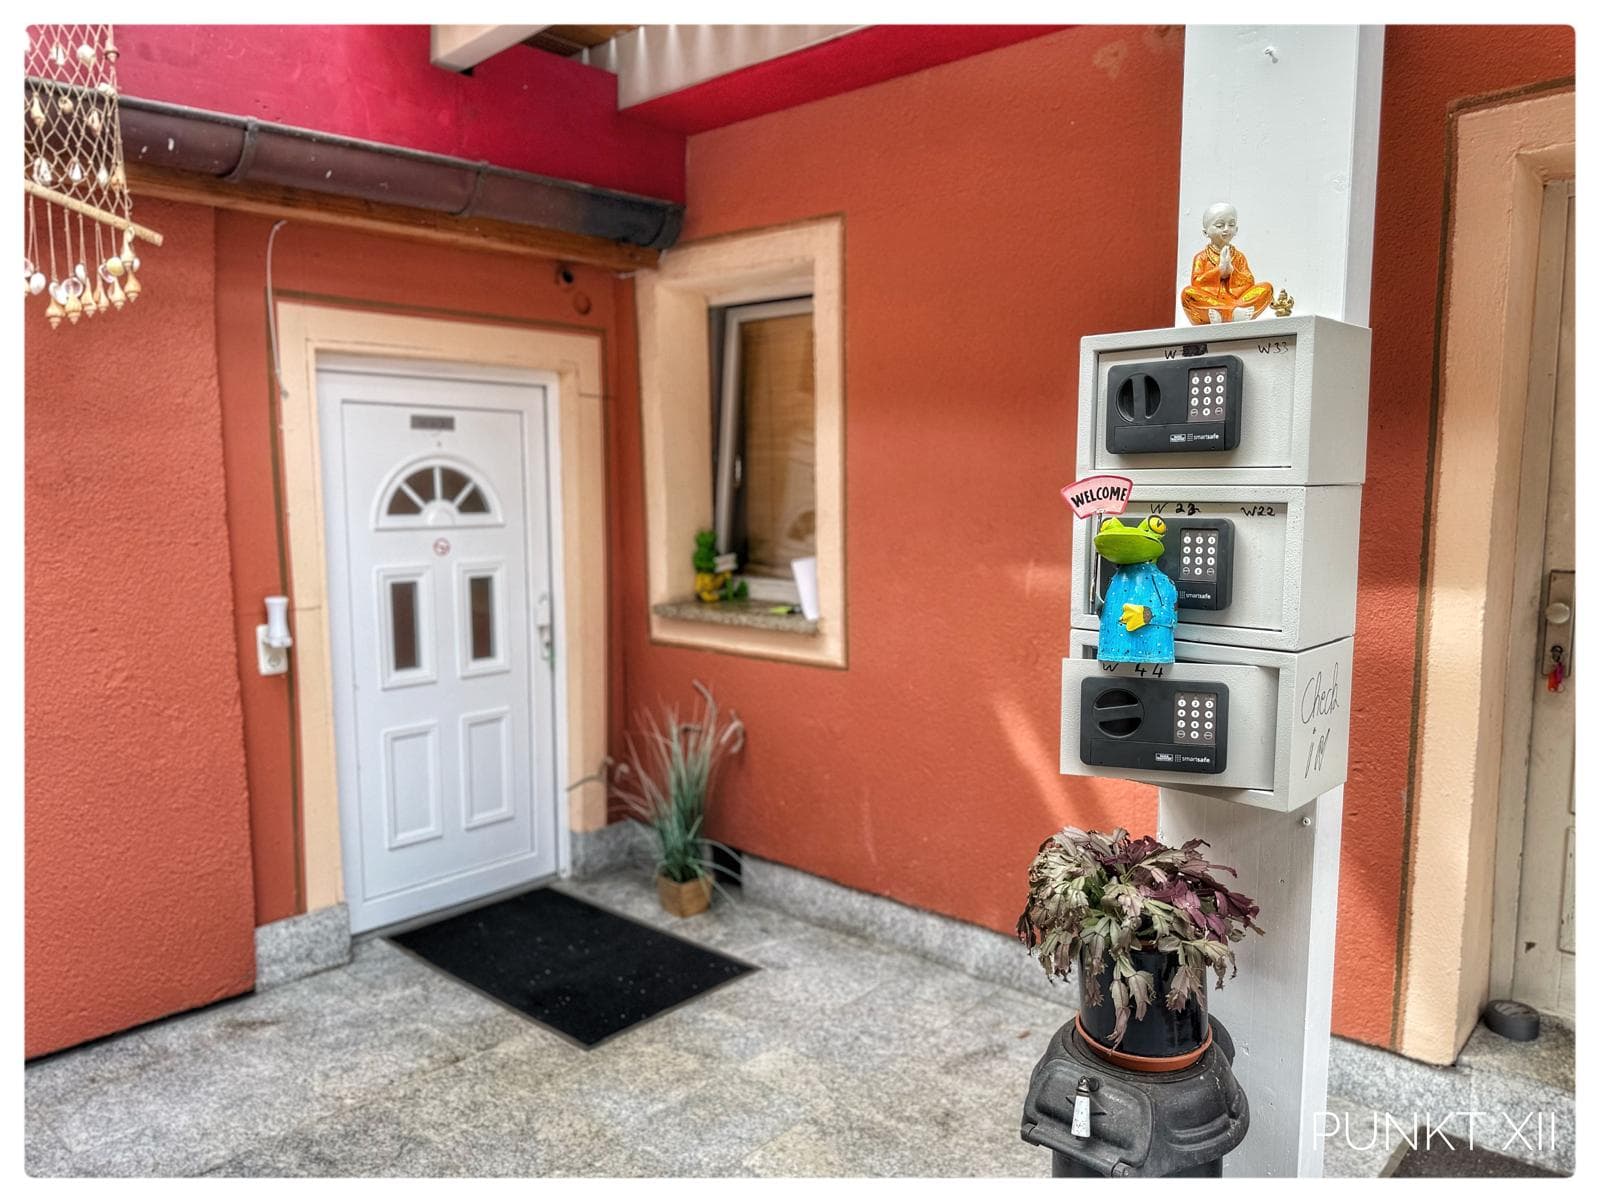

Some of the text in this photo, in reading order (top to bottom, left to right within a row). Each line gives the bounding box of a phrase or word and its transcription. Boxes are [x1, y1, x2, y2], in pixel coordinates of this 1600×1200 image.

[1164, 349, 1177, 359] W
[1070, 486, 1128, 508] WELCOME
[1150, 502, 1168, 514] W
[1135, 662, 1163, 678] 44
